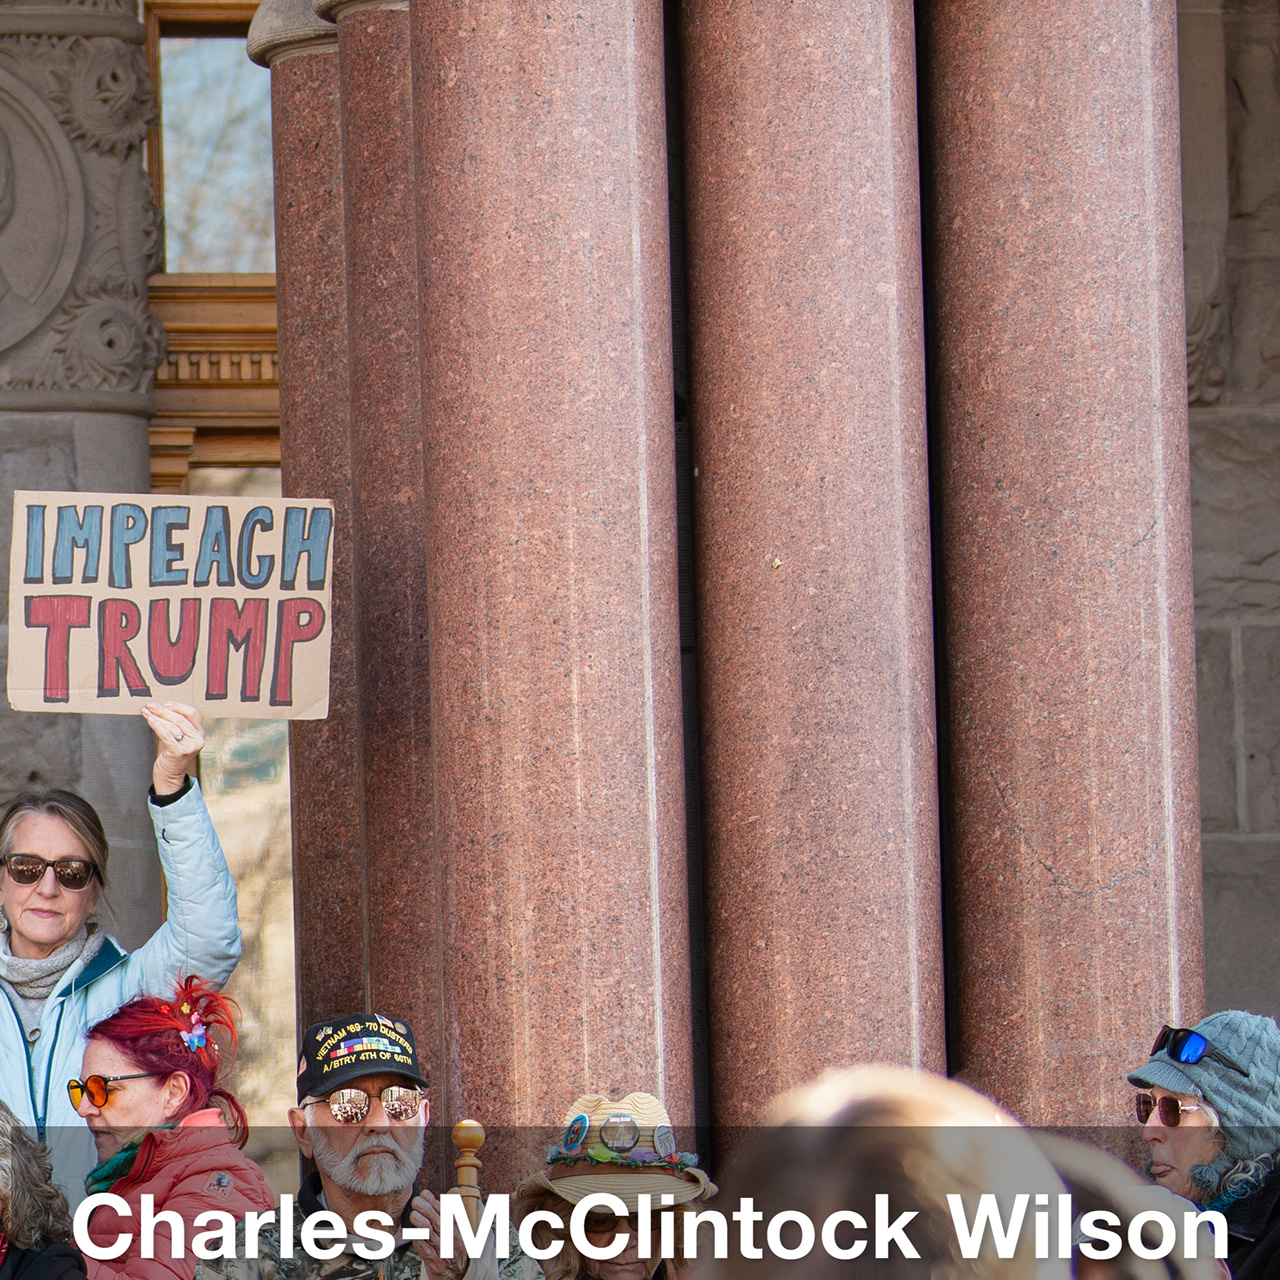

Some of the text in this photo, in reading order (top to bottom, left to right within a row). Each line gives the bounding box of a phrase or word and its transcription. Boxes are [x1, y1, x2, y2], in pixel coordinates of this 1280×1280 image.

[23, 504, 335, 590] IMPEACH
[24, 594, 326, 706] TRUMP
[316, 1029, 347, 1061] VIETNAM
[380, 1025, 413, 1054] DUSTERS
[322, 1055, 356, 1073] A/BTRY
[360, 1051, 377, 1060] 4TH
[379, 1052, 391, 1060] OF
